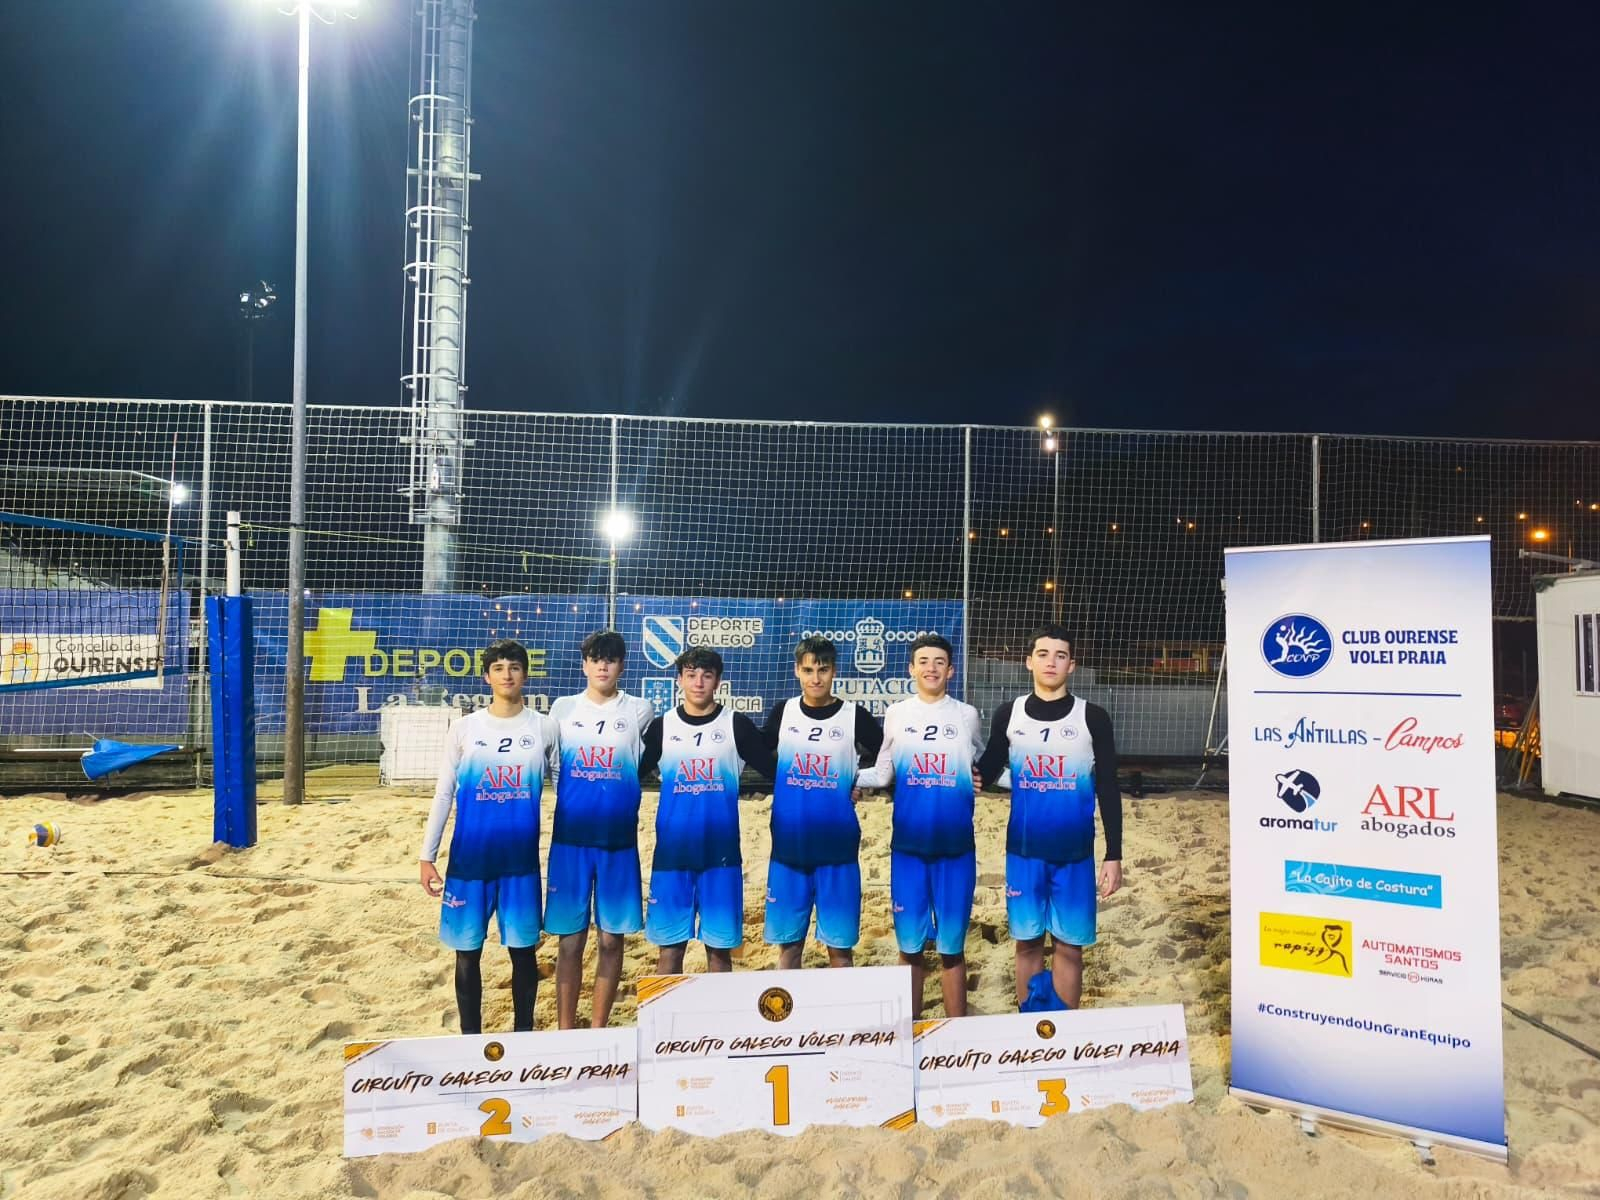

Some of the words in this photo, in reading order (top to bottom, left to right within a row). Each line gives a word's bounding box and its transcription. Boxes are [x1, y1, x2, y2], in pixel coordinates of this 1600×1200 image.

[688, 619, 762, 632] DEPORTE
[55, 638, 118, 652] Concello
[125, 638, 141, 652] de
[688, 633, 754, 646] GALEGO
[1342, 630, 1380, 645] CLUB
[1385, 629, 1459, 645] OURENSE
[1349, 650, 1394, 665] VOLEI
[1398, 650, 1447, 665] PRAIA
[595, 720, 605, 735] 1
[808, 727, 823, 742] 2
[923, 725, 938, 741] 2
[1039, 727, 1050, 743] 1
[1254, 726, 1282, 743] LAS
[1285, 716, 1367, 749] ANTILLAS
[1384, 716, 1464, 754] Campos
[498, 737, 513, 753] 2
[692, 731, 703, 747] 1
[572, 745, 623, 769] ARL
[789, 752, 840, 778] ARL
[906, 752, 957, 777] ARL
[570, 768, 621, 782] abogados
[673, 757, 724, 782] ARL
[1018, 754, 1079, 779] ARL
[476, 764, 533, 790] ARL
[787, 776, 838, 790] abogados
[906, 774, 957, 789] abogados
[1018, 777, 1077, 793] abogados
[475, 789, 531, 804] abogados
[673, 781, 725, 795] abogados
[1361, 783, 1455, 822] ARL
[1259, 816, 1338, 833] aromatur
[1360, 816, 1456, 839] abogados
[1314, 872, 1353, 889] Cajita
[1356, 876, 1373, 890] de
[1362, 939, 1462, 962] AUTOMATISMOS
[1384, 953, 1439, 970] SANTOS
[1420, 975, 1443, 985] HORAS
[1257, 1002, 1471, 1049] #ConstruyendoUnGranEquipo
[728, 1036, 793, 1051] GALEGO
[849, 1031, 896, 1046] PRAIA
[997, 1047, 1067, 1066] GALEGO
[1129, 1040, 1181, 1059] PRAIA
[439, 1069, 513, 1087] GALEGO
[576, 1063, 631, 1080] PRAIA
[764, 1064, 790, 1126] 1
[1037, 1078, 1071, 1117] 3
[478, 1097, 512, 1136] 2
